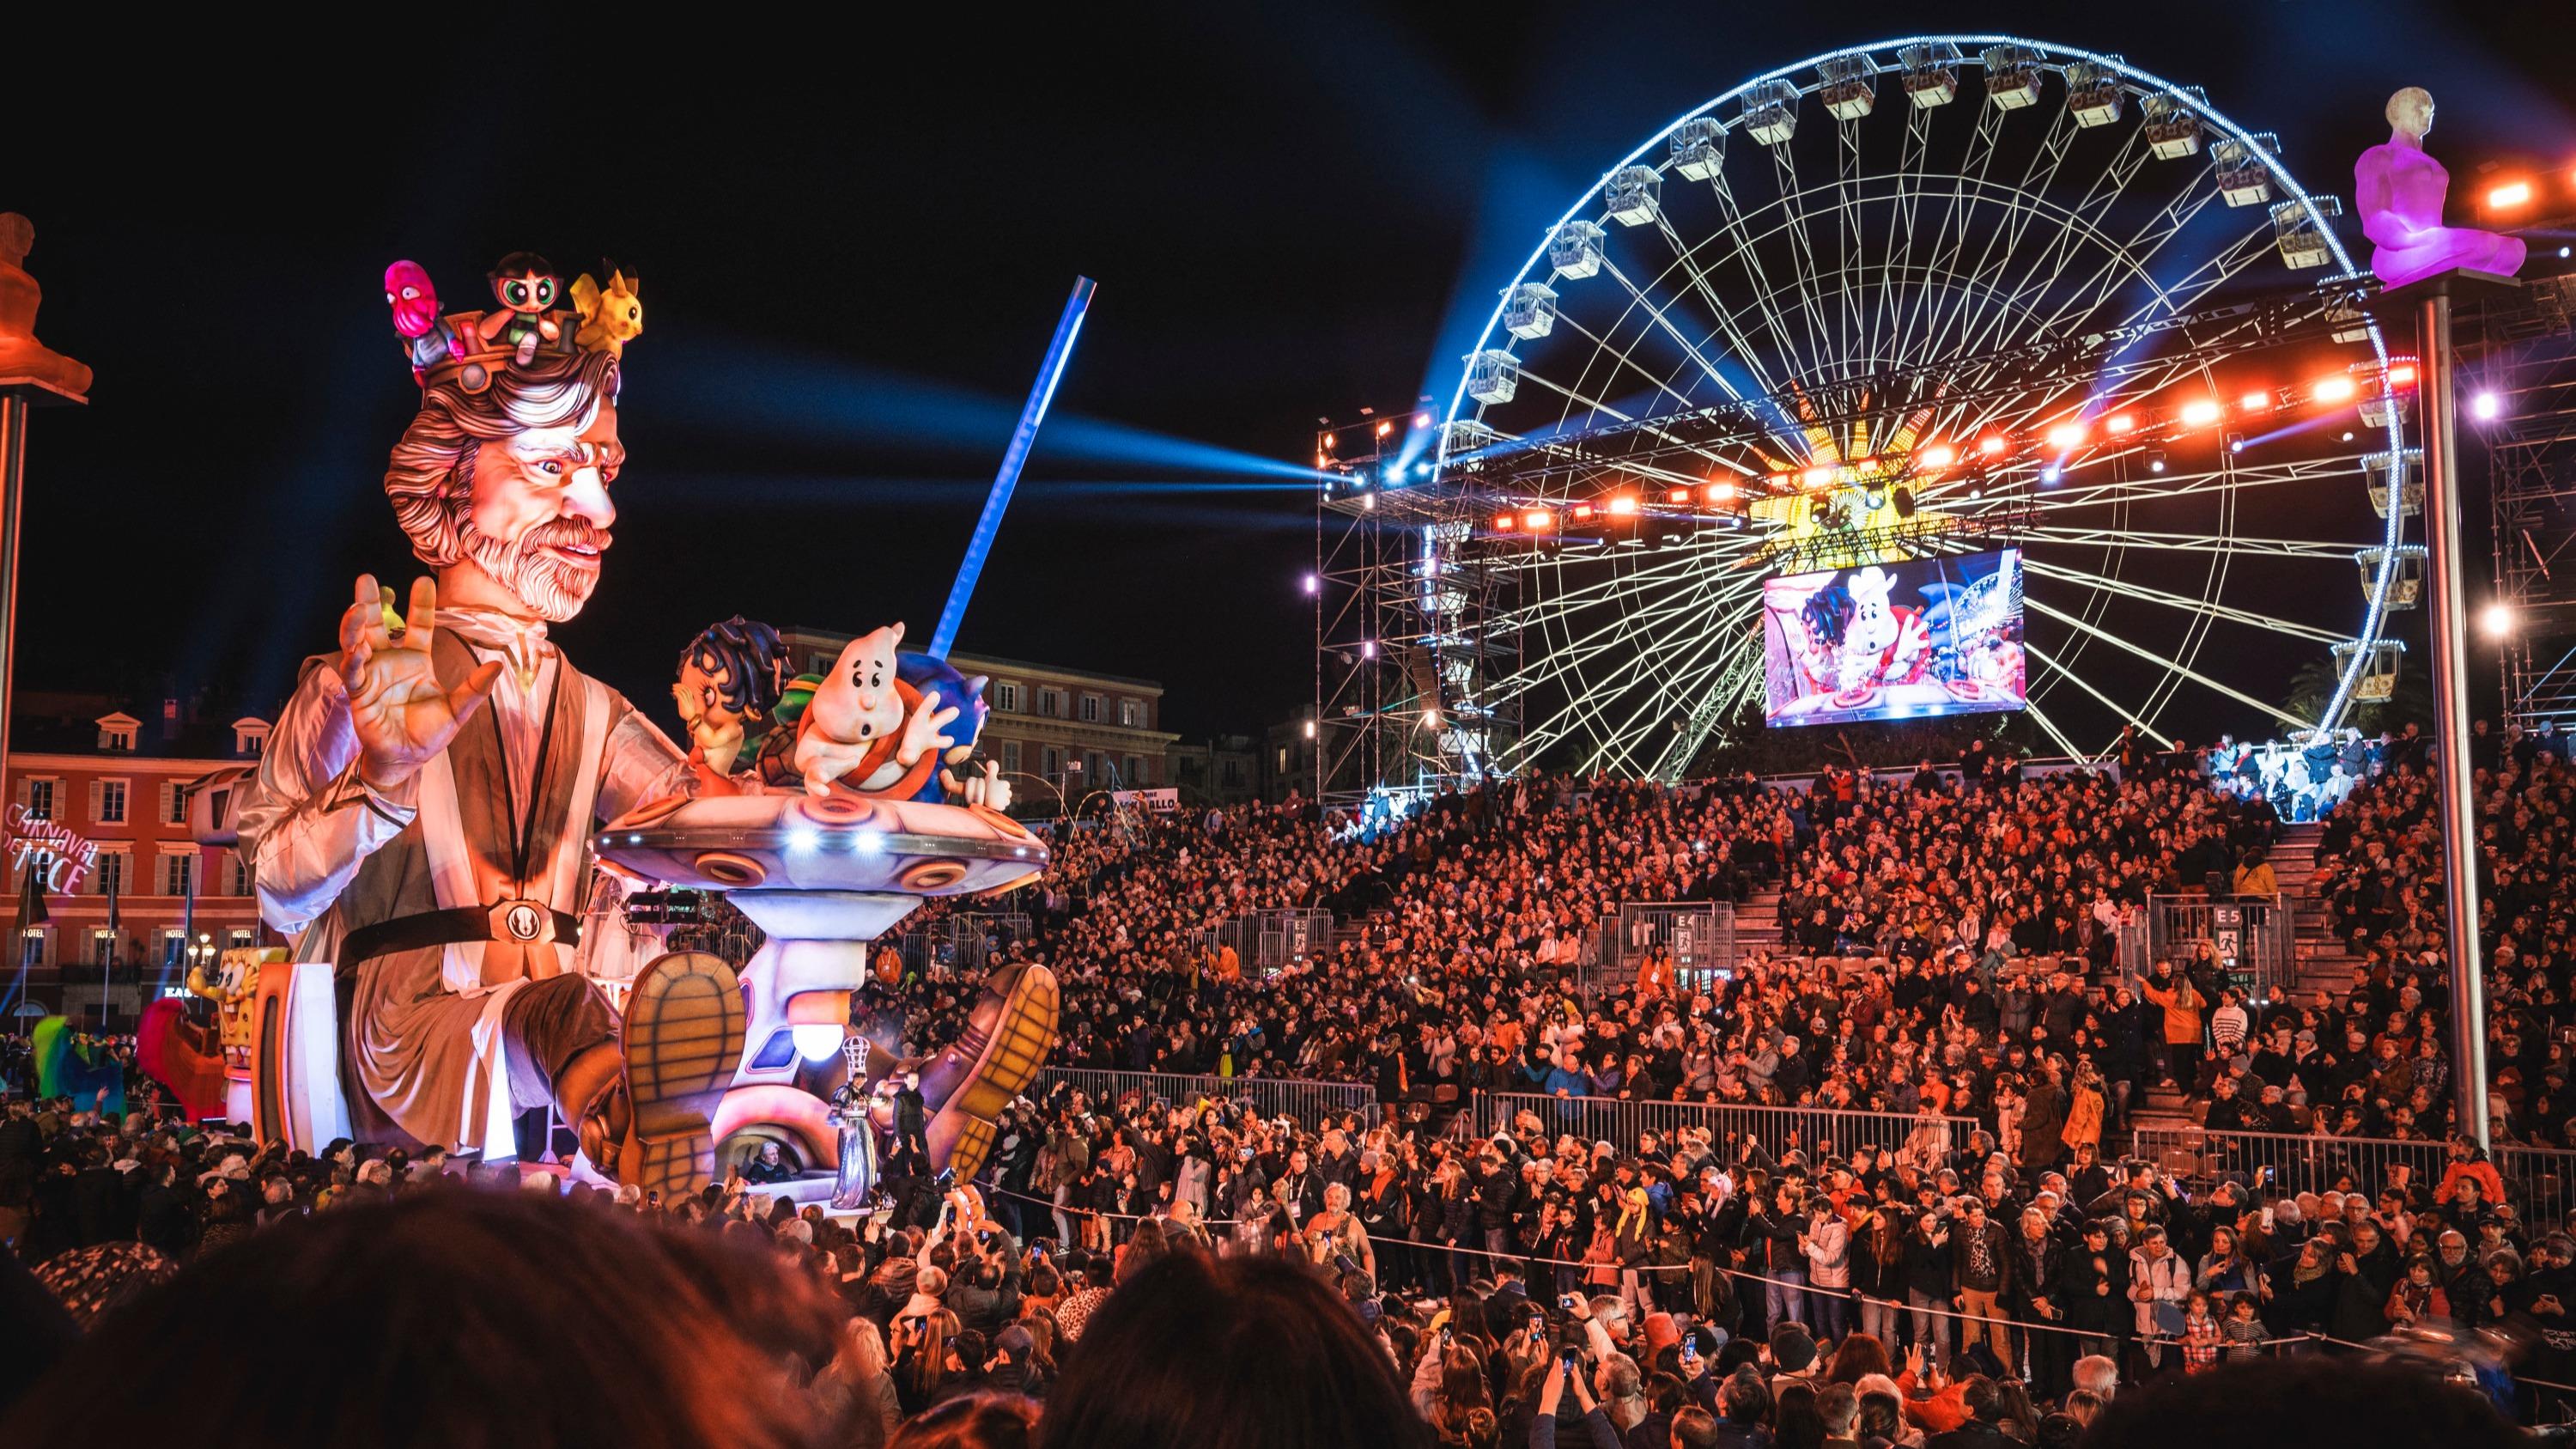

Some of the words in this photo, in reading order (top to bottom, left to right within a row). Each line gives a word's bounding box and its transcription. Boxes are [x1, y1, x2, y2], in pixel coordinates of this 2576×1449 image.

[1149, 799, 1175, 809] ALLO
[5, 803, 99, 868] CARNAVAL
[14, 841, 88, 898] NICE
[22, 928, 44, 938] HOTEL
[95, 929, 116, 939] HOTEL
[166, 929, 185, 938] HOTEL
[232, 929, 252, 938] HOTEL
[165, 987, 199, 997] EAS
